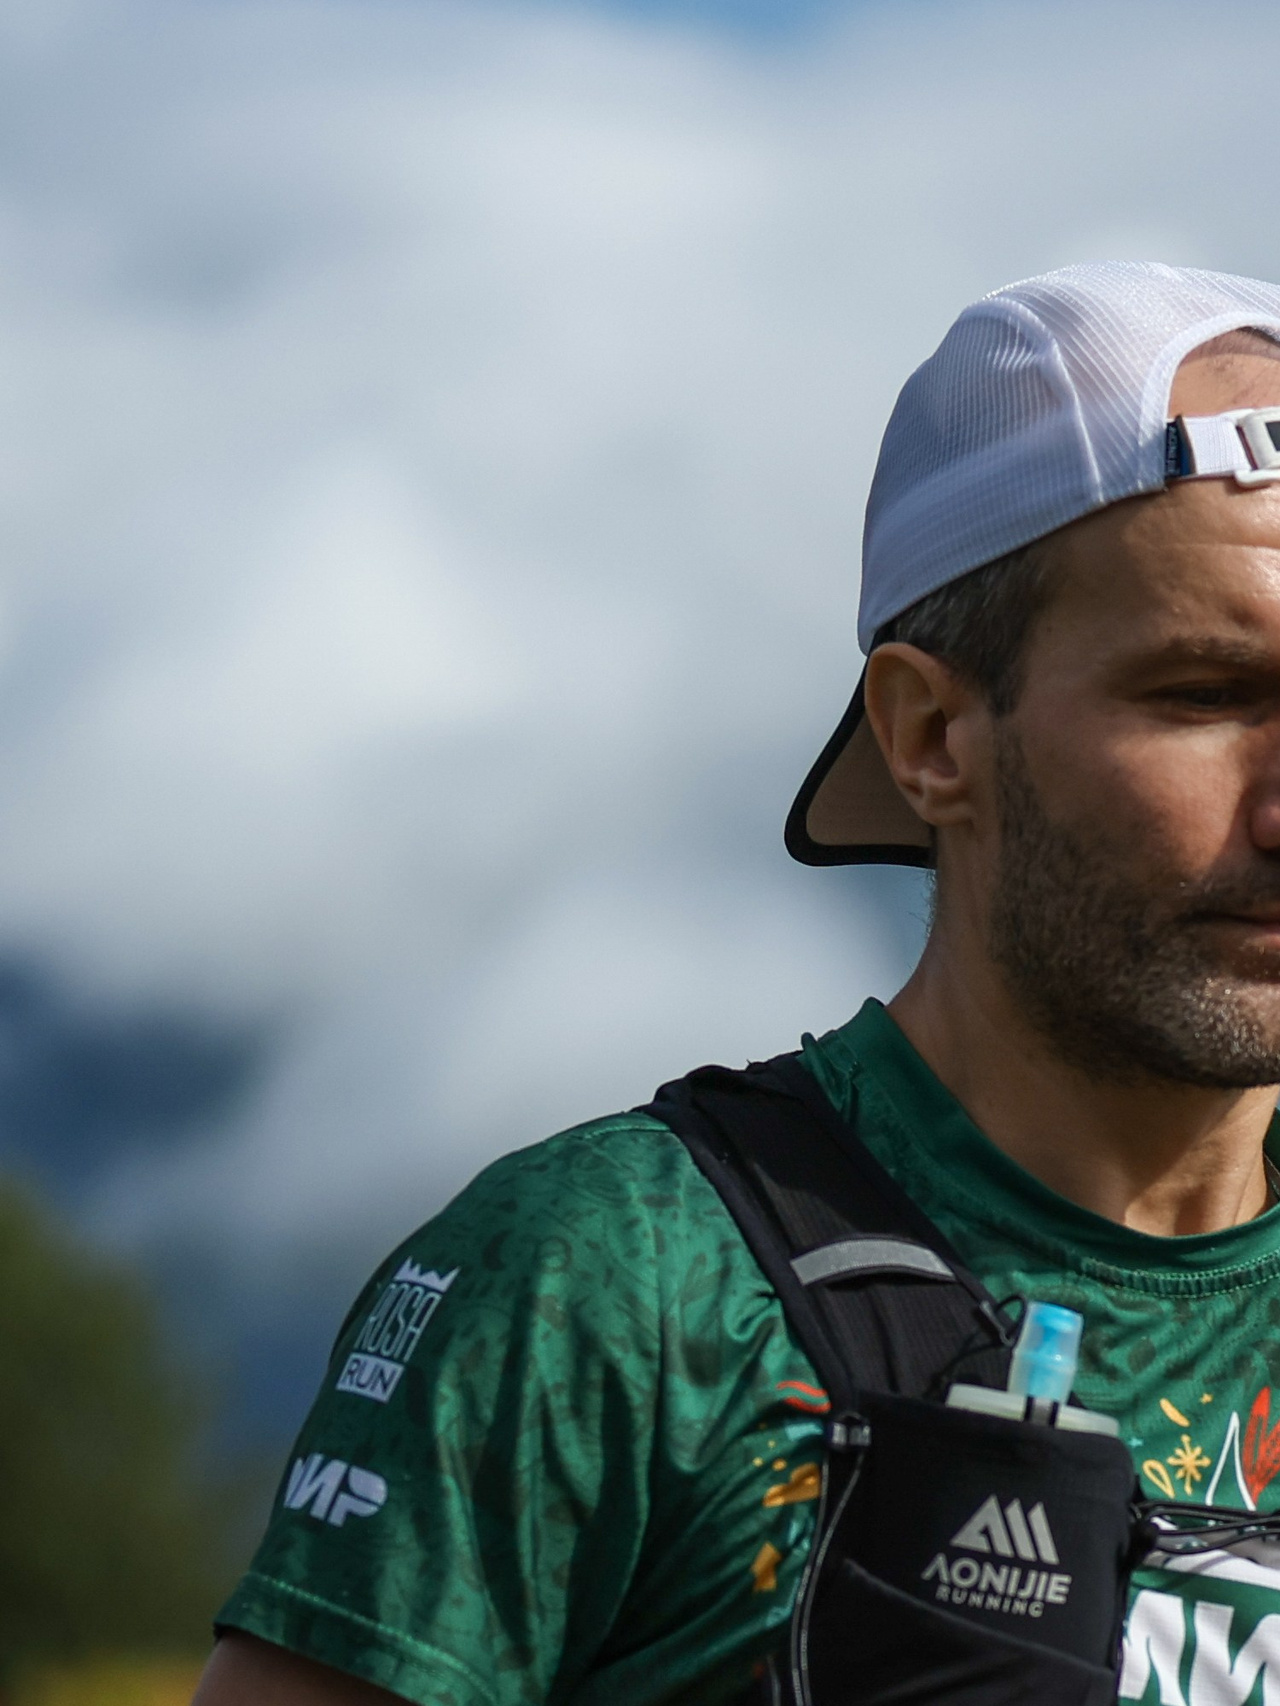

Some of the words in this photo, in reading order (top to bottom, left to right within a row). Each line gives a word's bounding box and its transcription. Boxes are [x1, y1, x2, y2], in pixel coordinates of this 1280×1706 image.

[354, 1283, 443, 1363] ROSA
[343, 1358, 397, 1394] RUN
[920, 1552, 1073, 1605] AONIJIE
[935, 1583, 1045, 1618] RUNNING
